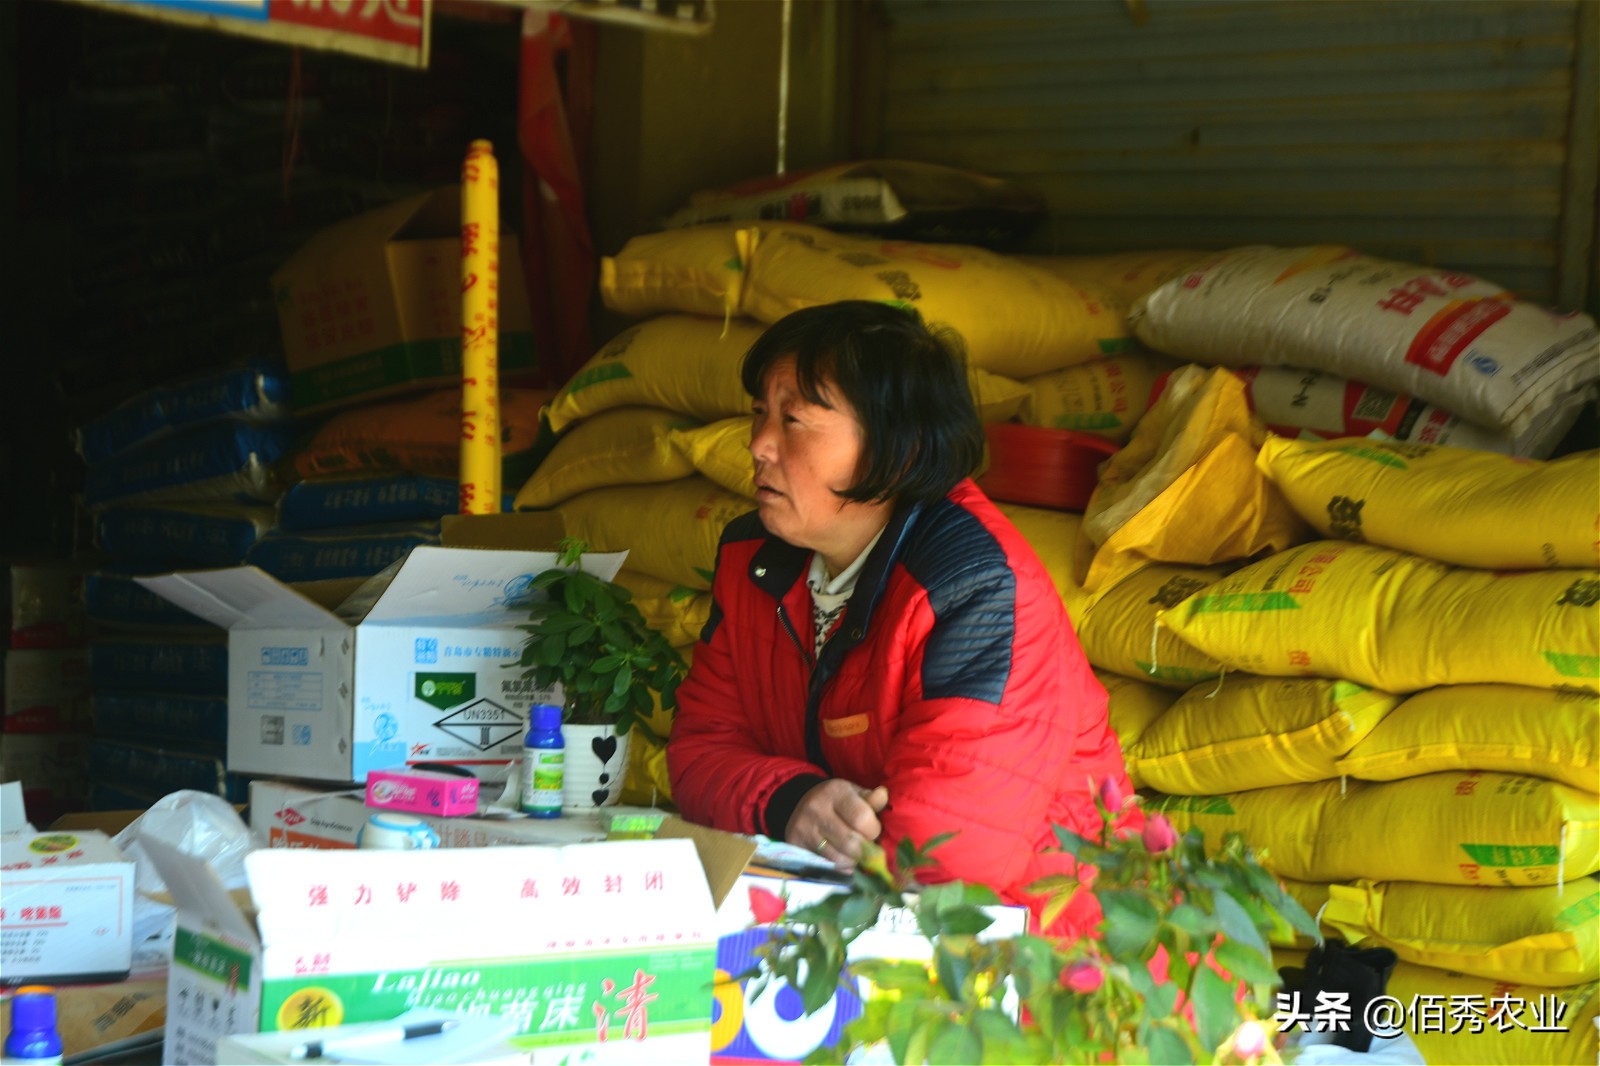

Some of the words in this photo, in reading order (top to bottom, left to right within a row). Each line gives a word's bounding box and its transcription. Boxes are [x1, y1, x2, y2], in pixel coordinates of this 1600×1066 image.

[463, 709, 505, 720] UN3351
[308, 880, 462, 907] 强力铲除
[519, 871, 664, 899] 高效封闭
[292, 995, 329, 1030] 新
[592, 967, 658, 1044] 清
